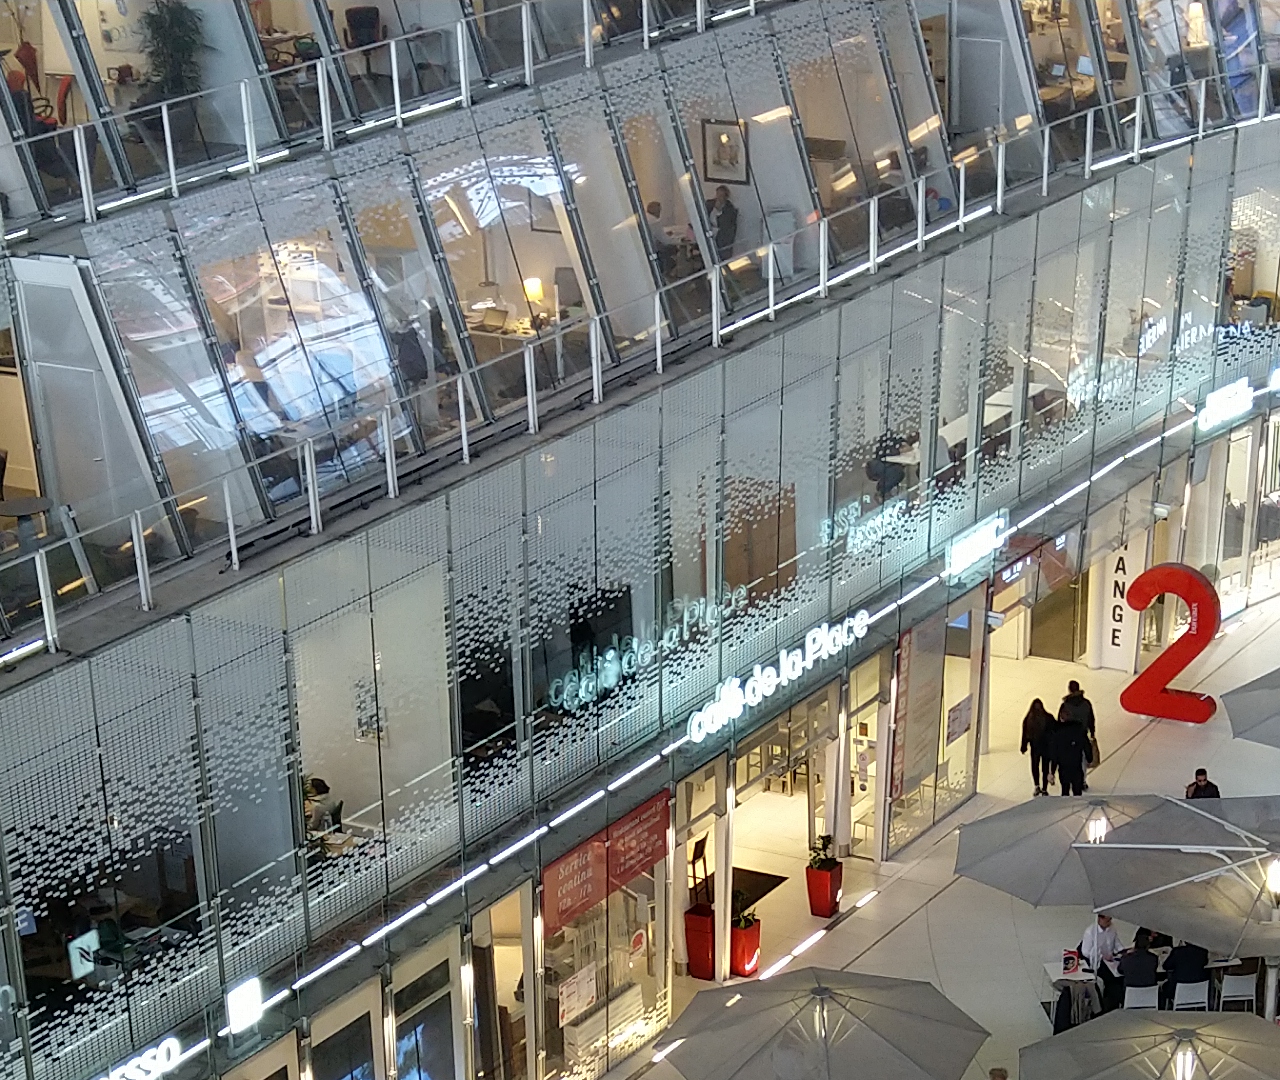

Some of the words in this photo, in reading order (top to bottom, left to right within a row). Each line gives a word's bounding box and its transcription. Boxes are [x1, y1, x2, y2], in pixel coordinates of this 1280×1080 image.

[1111, 543, 1127, 647] ANGE
[1120, 563, 1221, 724] 2
[745, 664, 777, 707] de
[779, 649, 803, 686] la
[804, 609, 870, 670] Place
[557, 868, 593, 898] continu
[558, 850, 592, 880] Service
